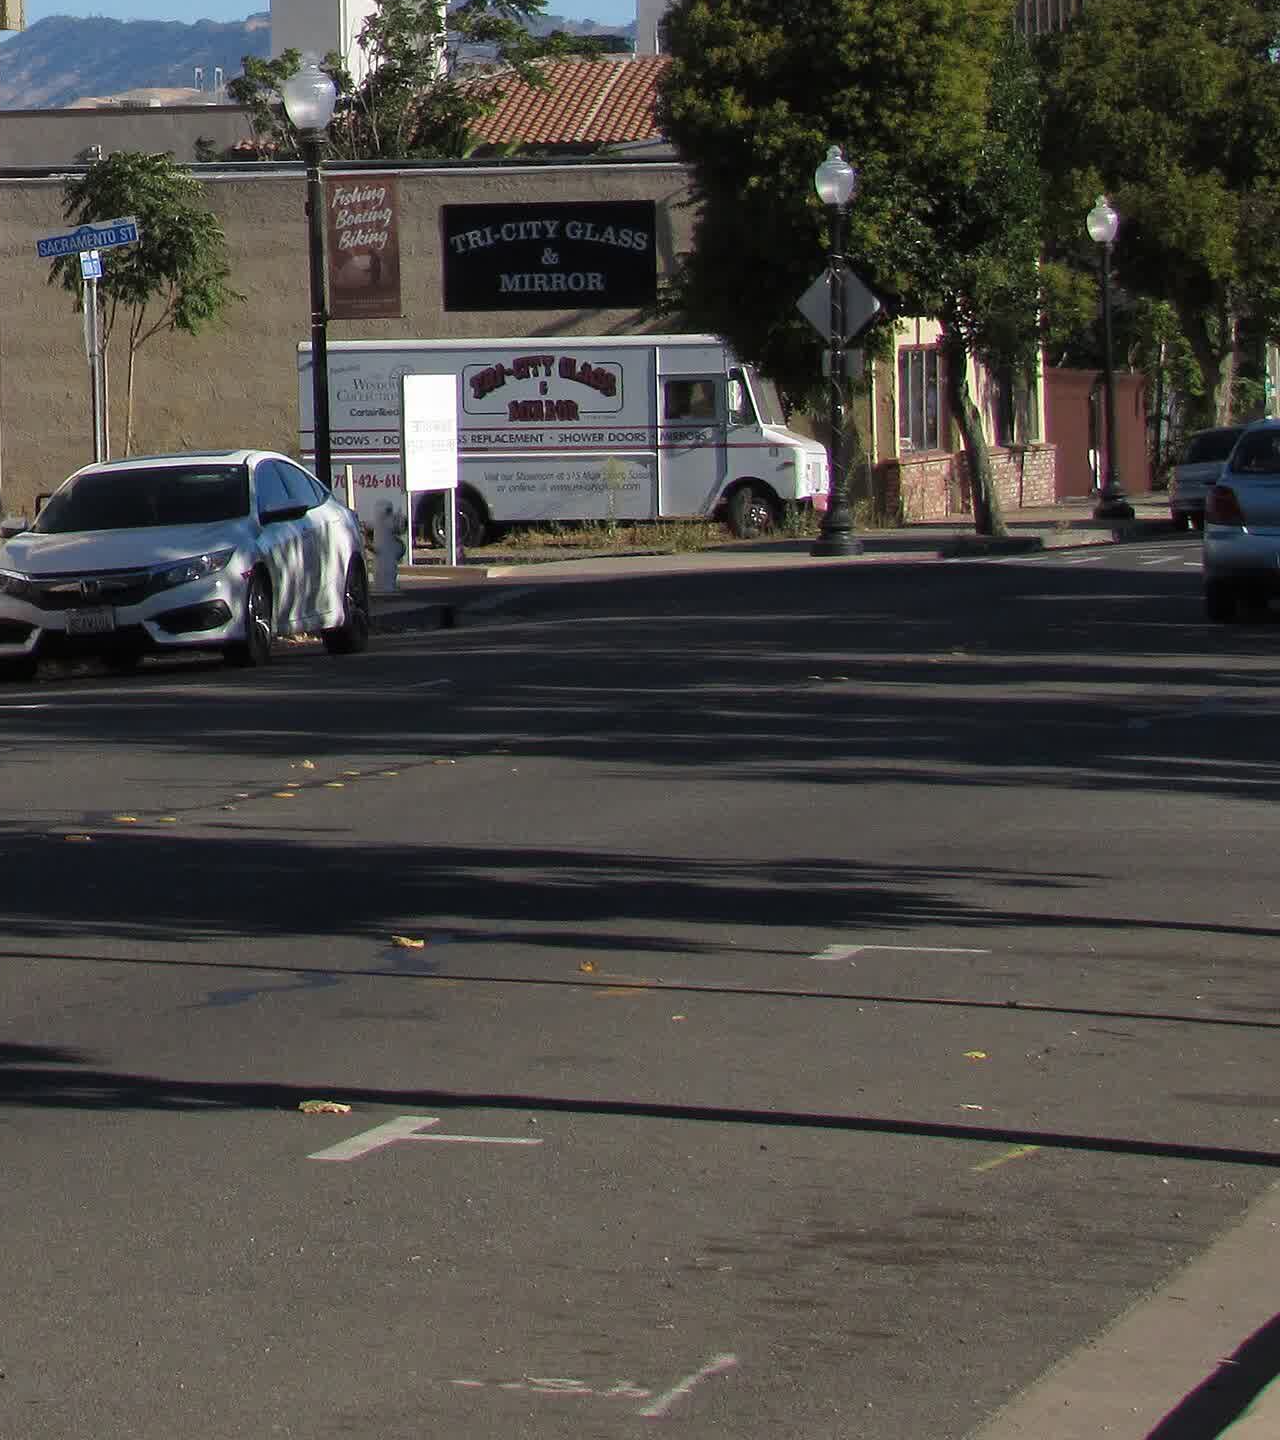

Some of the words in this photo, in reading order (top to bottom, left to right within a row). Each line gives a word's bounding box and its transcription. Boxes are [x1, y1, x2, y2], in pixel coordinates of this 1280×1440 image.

[332, 185, 386, 209] Fishing
[336, 206, 393, 229] Boating
[40, 230, 117, 257] SACRAMENTO
[120, 227, 135, 242] ST
[339, 228, 389, 250] Biking
[450, 219, 561, 254] TRI-CITY
[565, 220, 649, 251] GLASS
[541, 248, 560, 265] &
[498, 272, 606, 292] MIRROR
[330, 436, 370, 445] NDOWS
[470, 433, 544, 443] REPLACEMENT
[558, 432, 605, 443] SHOWER
[608, 431, 647, 442] DOORS
